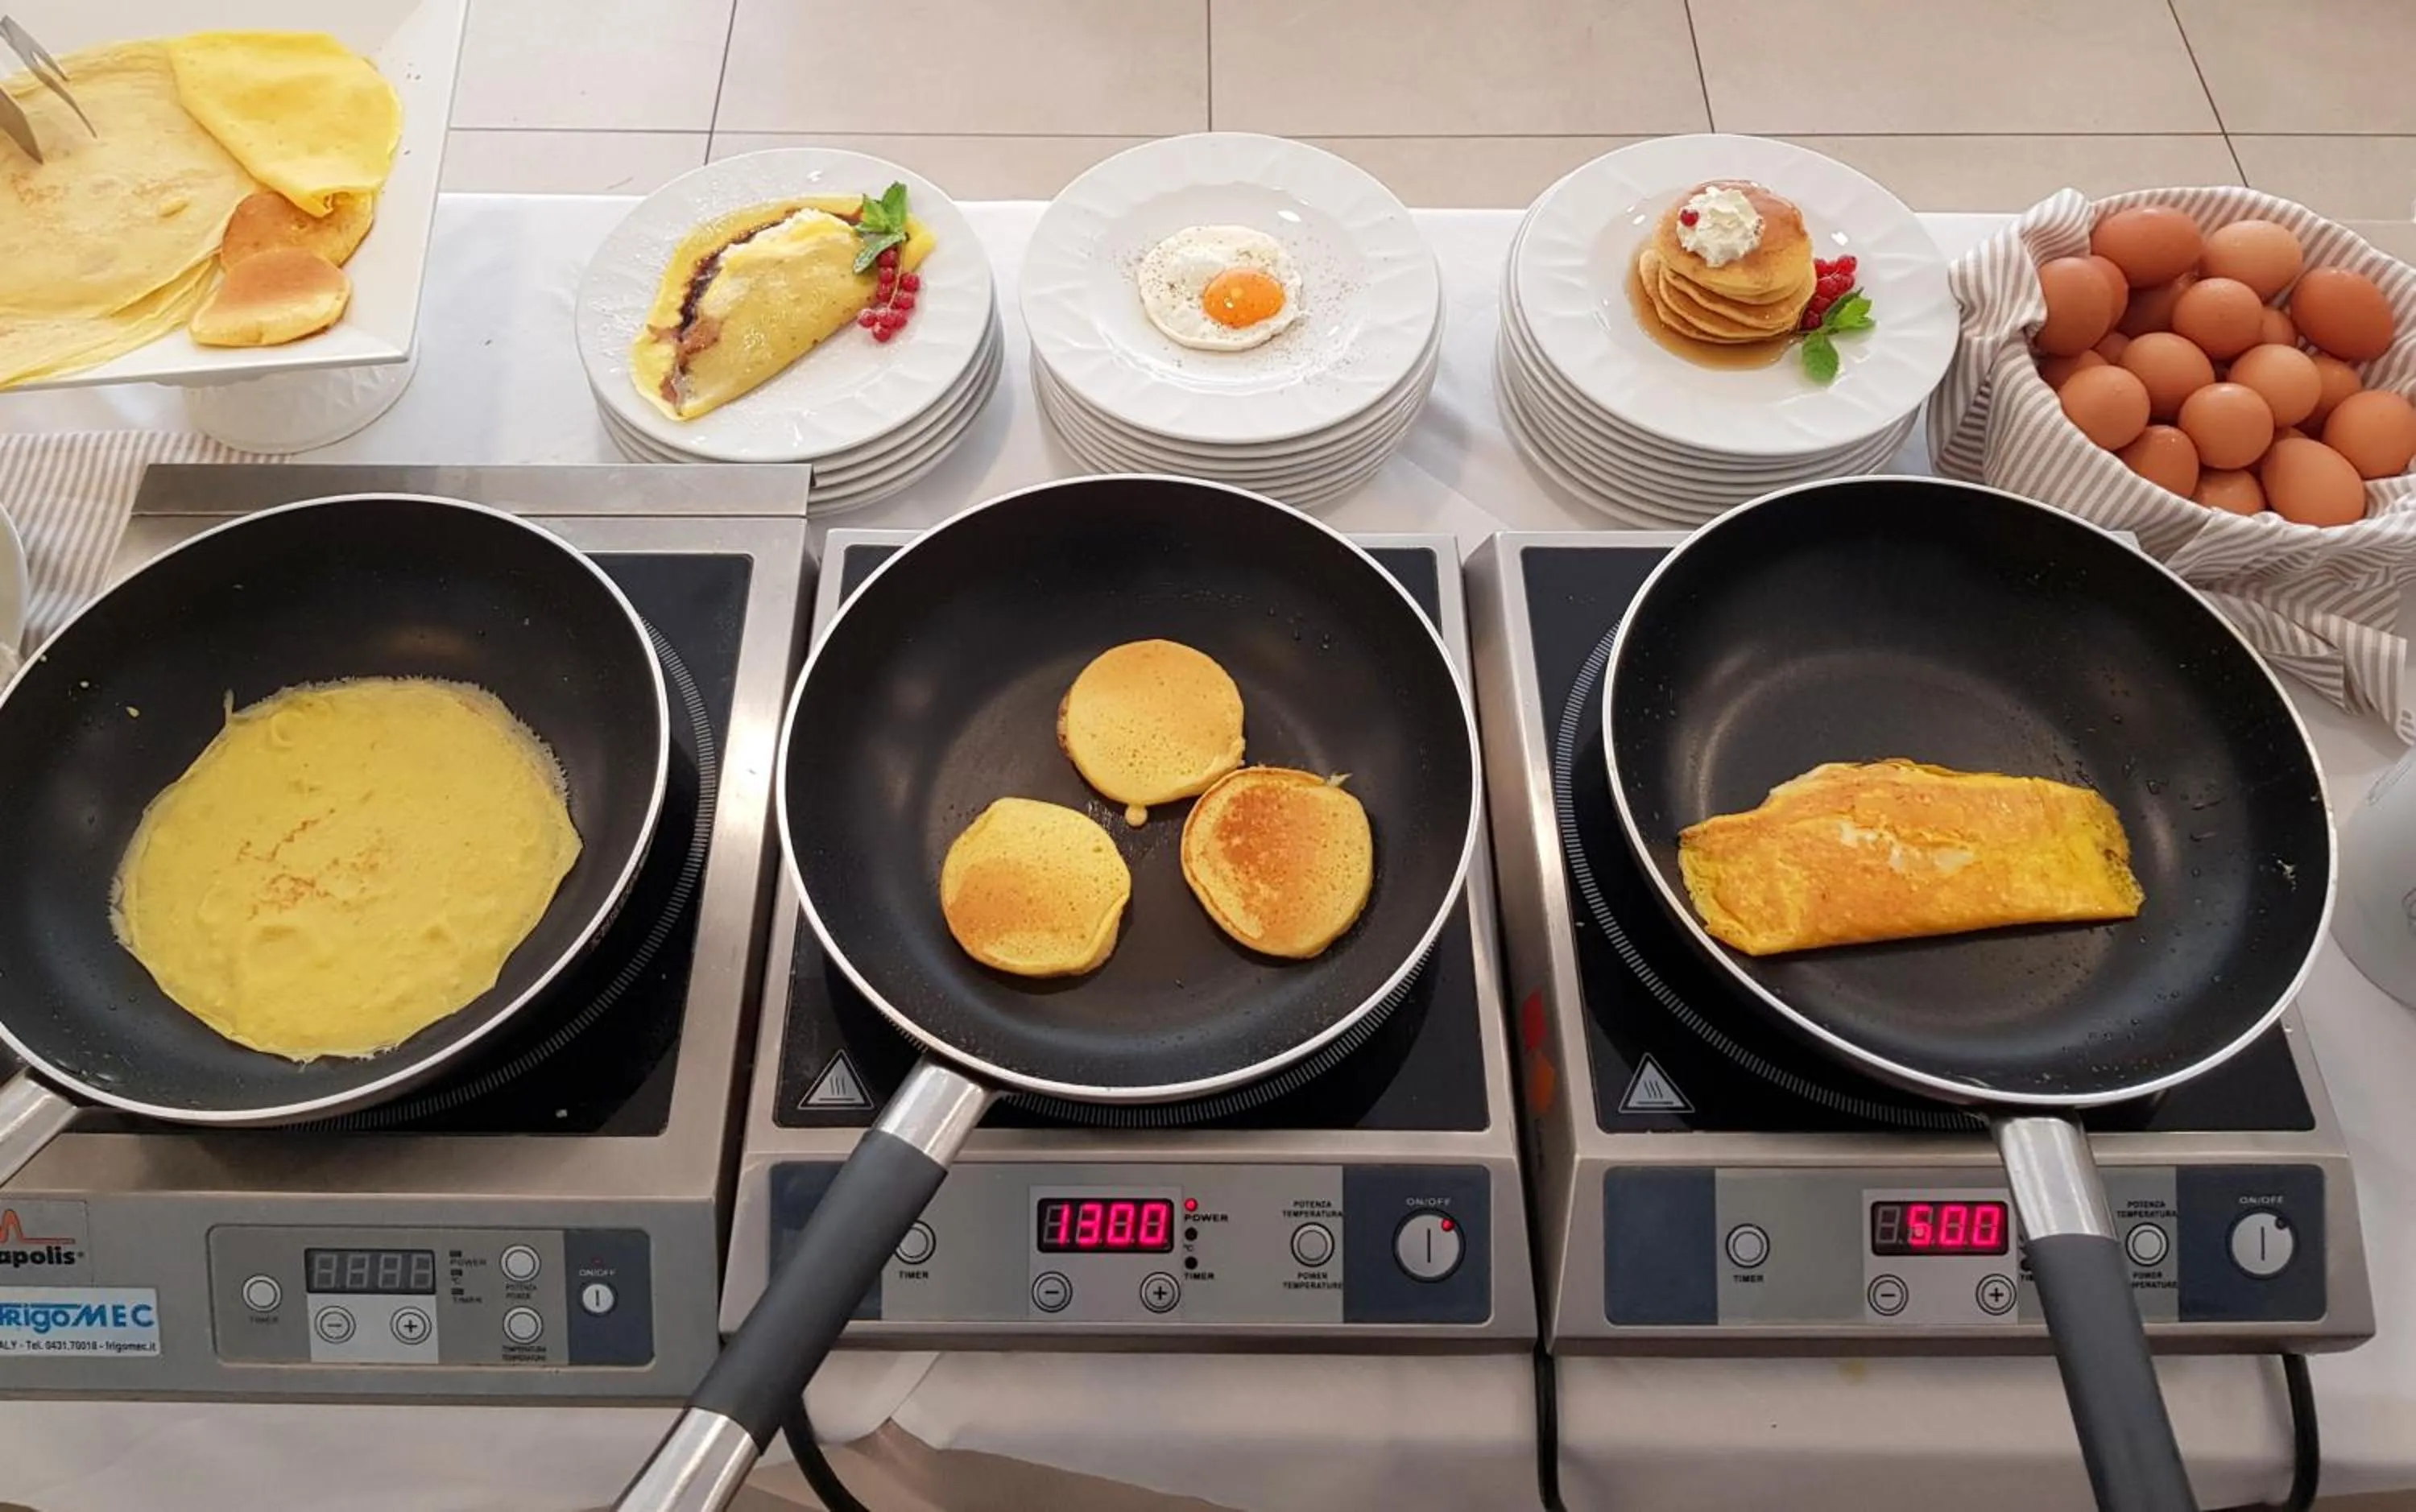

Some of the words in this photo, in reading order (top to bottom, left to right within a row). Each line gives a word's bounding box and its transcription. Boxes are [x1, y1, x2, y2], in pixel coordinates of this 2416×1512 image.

[1293, 1200, 1331, 1208] POTENZA
[1406, 1197, 1450, 1206] ON/OFF
[2128, 1200, 2166, 1208] POTENZA
[2239, 1196, 2284, 1205] ON/OFF
[1185, 1214, 1229, 1222] POWER
[1058, 1202, 1168, 1246] 1300
[1908, 1203, 2000, 1246] 500
[899, 1270, 929, 1279] TIMER
[1297, 1272, 1328, 1280] POWER
[1733, 1274, 1764, 1283] TIMER
